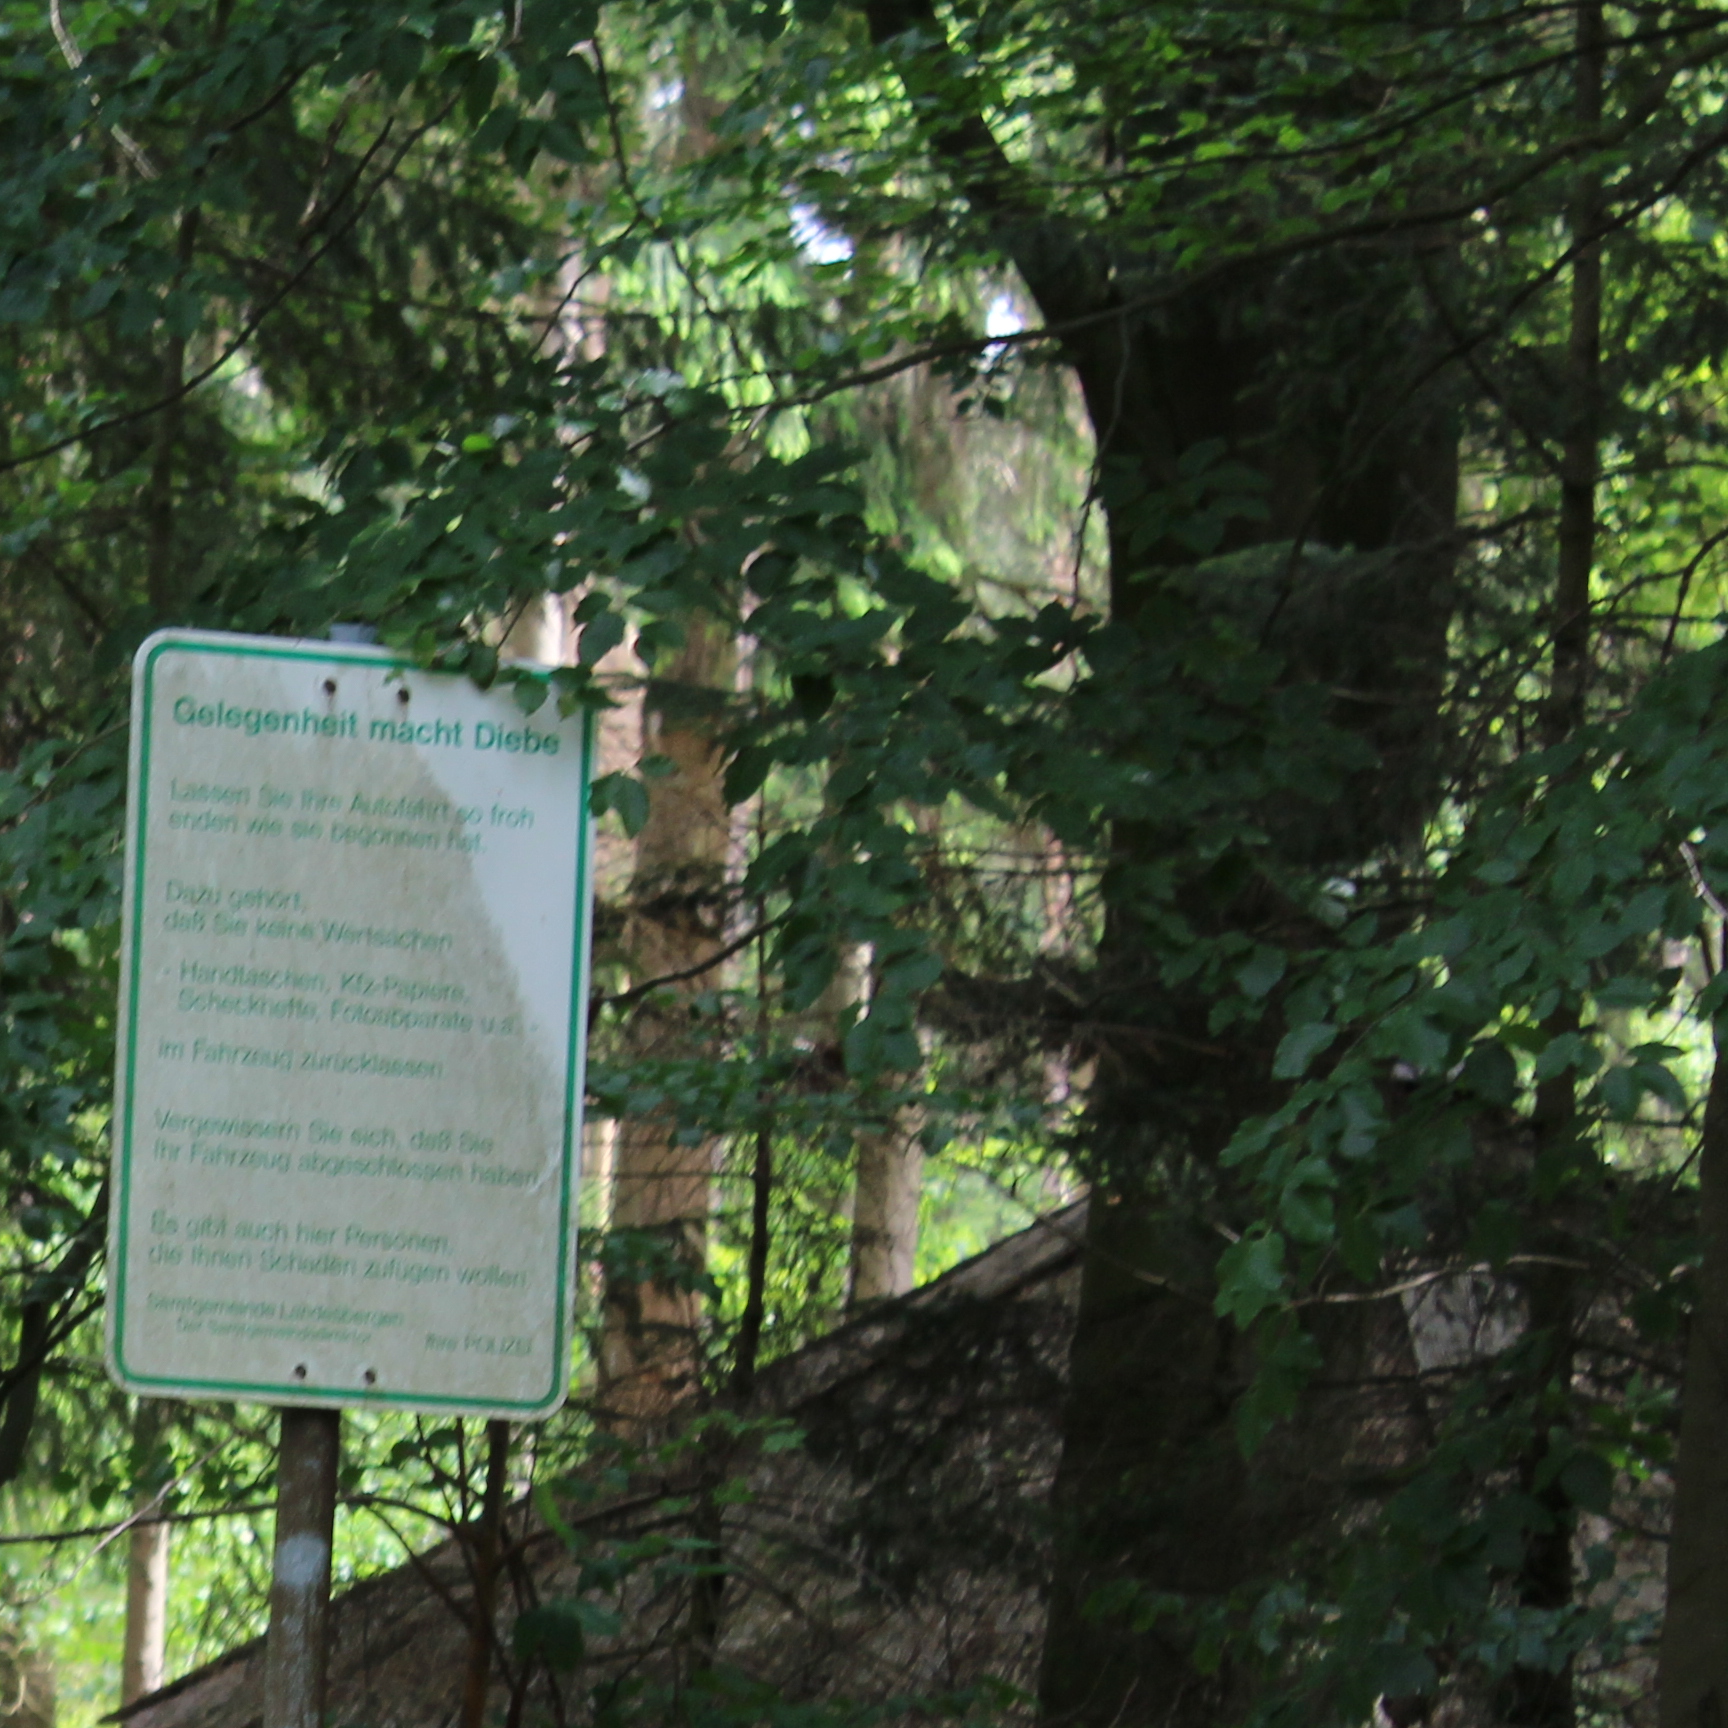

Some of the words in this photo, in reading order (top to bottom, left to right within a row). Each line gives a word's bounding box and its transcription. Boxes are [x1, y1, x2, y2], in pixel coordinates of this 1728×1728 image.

[172, 694, 359, 738] Gelegenheit
[369, 716, 463, 747] macht
[473, 719, 561, 756] Diebe
[169, 776, 251, 807] Lassen
[258, 781, 293, 810] Sie
[301, 787, 342, 812] Ihre
[347, 790, 450, 822] Autofahrt
[455, 804, 484, 826] so
[490, 801, 536, 830] froh
[167, 807, 238, 834] enden
[245, 813, 285, 837] wie
[330, 819, 439, 850] begonnen
[165, 878, 222, 906] Dazu
[213, 911, 248, 937] Sie
[255, 916, 316, 940] keine
[318, 917, 455, 952] Wertsachen
[330, 997, 475, 1034] Fotoapparate
[192, 1036, 293, 1073] Fahrzeug
[153, 1107, 301, 1141] Vergewissern
[308, 1117, 343, 1145] Sie
[458, 1129, 495, 1156] Sie
[153, 1135, 182, 1163] Ihr
[188, 1139, 293, 1174] Fahrzeug
[297, 1150, 464, 1183] abgeschlossen
[150, 1208, 180, 1235] Es
[185, 1213, 227, 1241] gibt
[234, 1217, 289, 1244] auch
[295, 1219, 340, 1246] hier
[147, 1241, 183, 1266] die
[191, 1243, 252, 1270] Ihnen
[259, 1247, 357, 1277] Schaden
